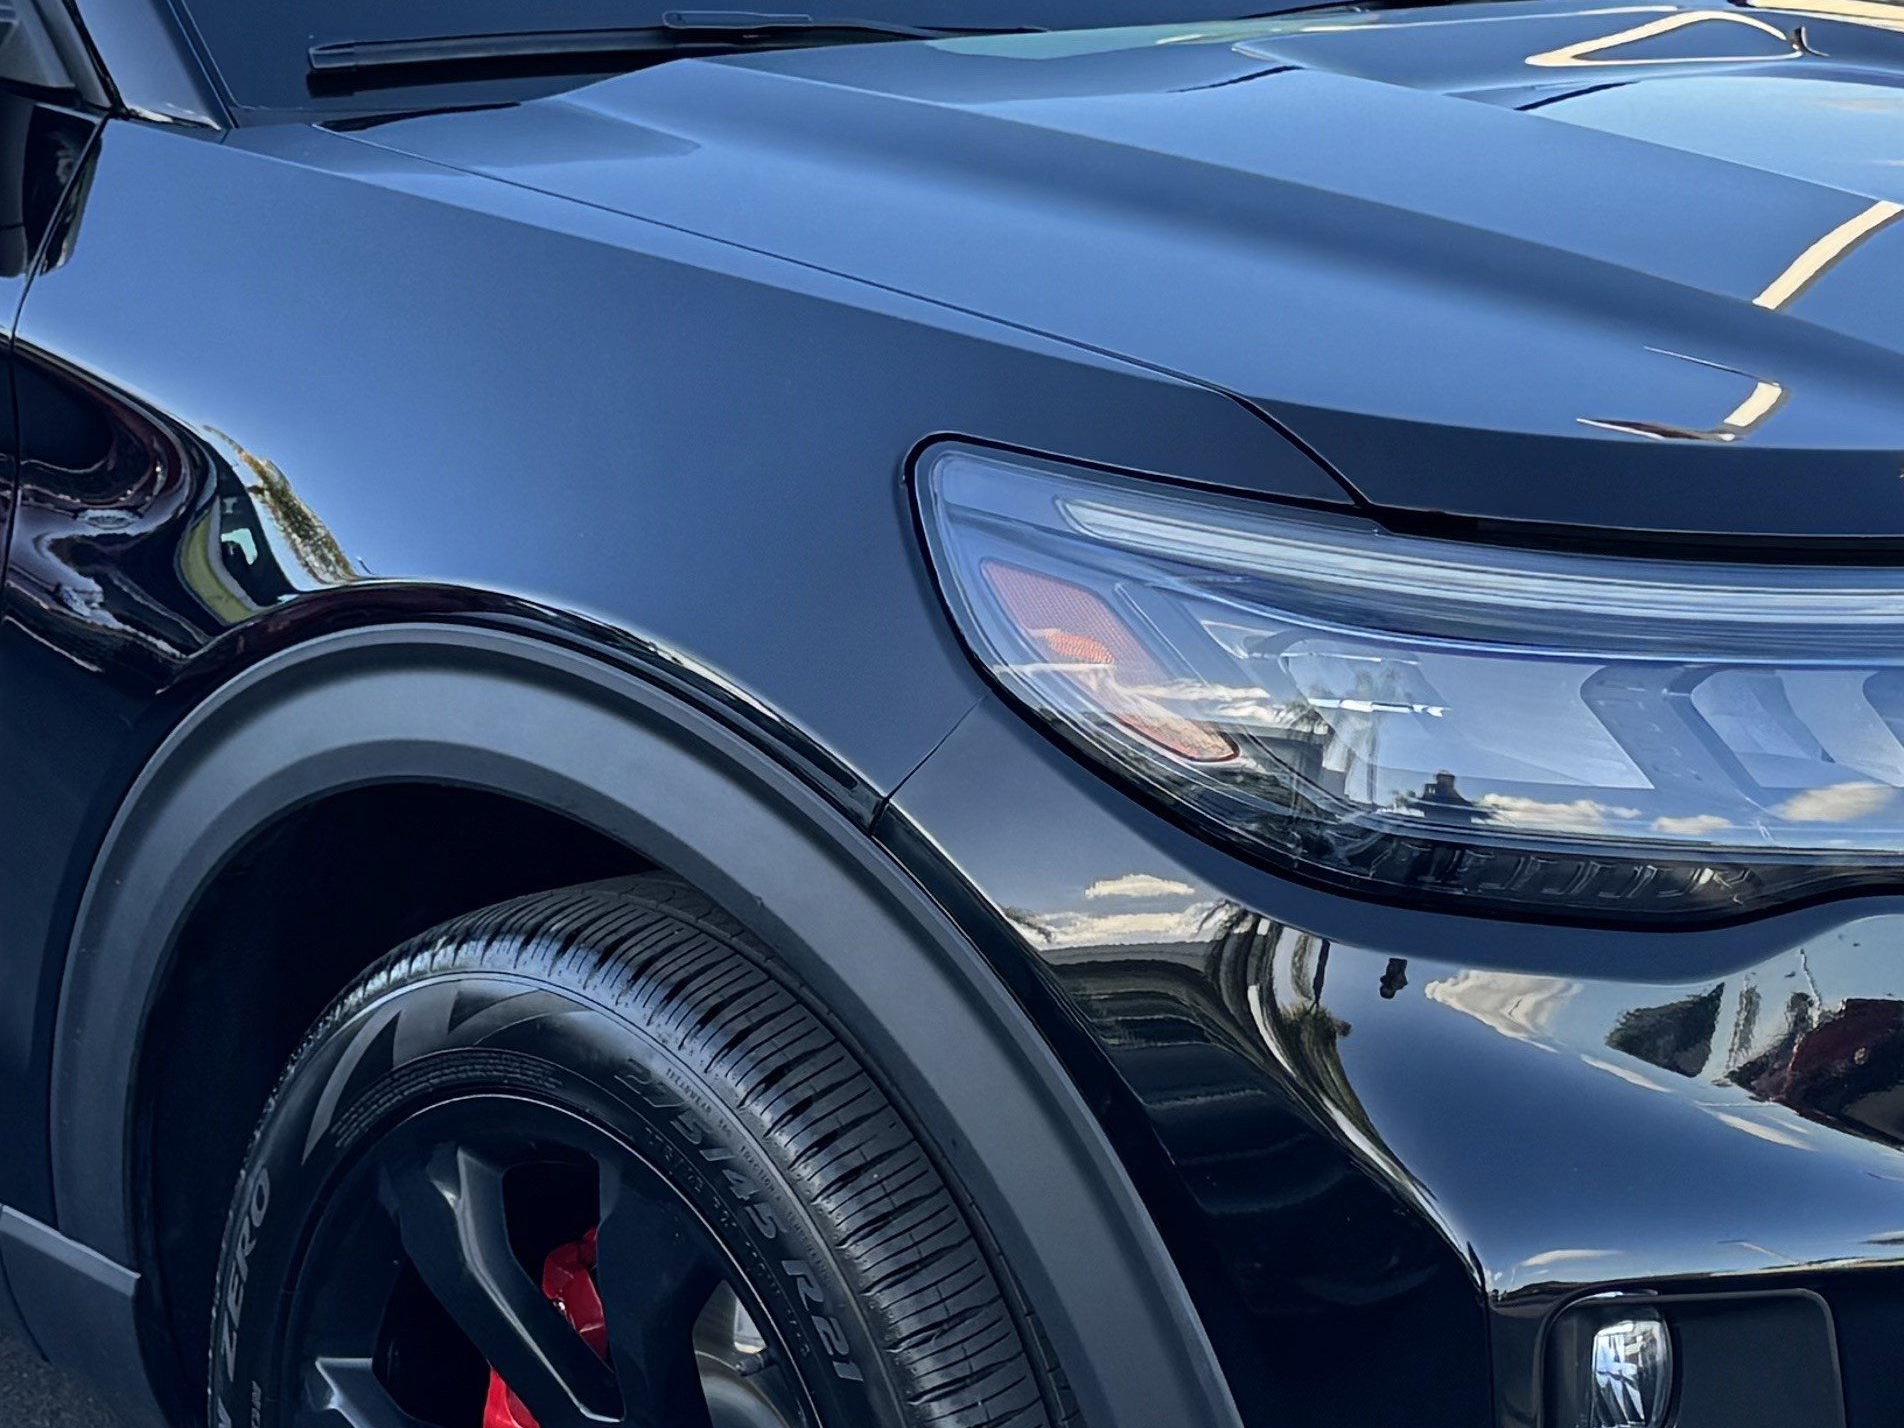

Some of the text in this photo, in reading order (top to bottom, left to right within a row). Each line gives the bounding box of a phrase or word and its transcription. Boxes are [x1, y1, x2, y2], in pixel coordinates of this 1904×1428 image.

[221, 1167, 271, 1383] ZERO
[613, 1058, 790, 1240] 275/45
[781, 1259, 864, 1382] R21
